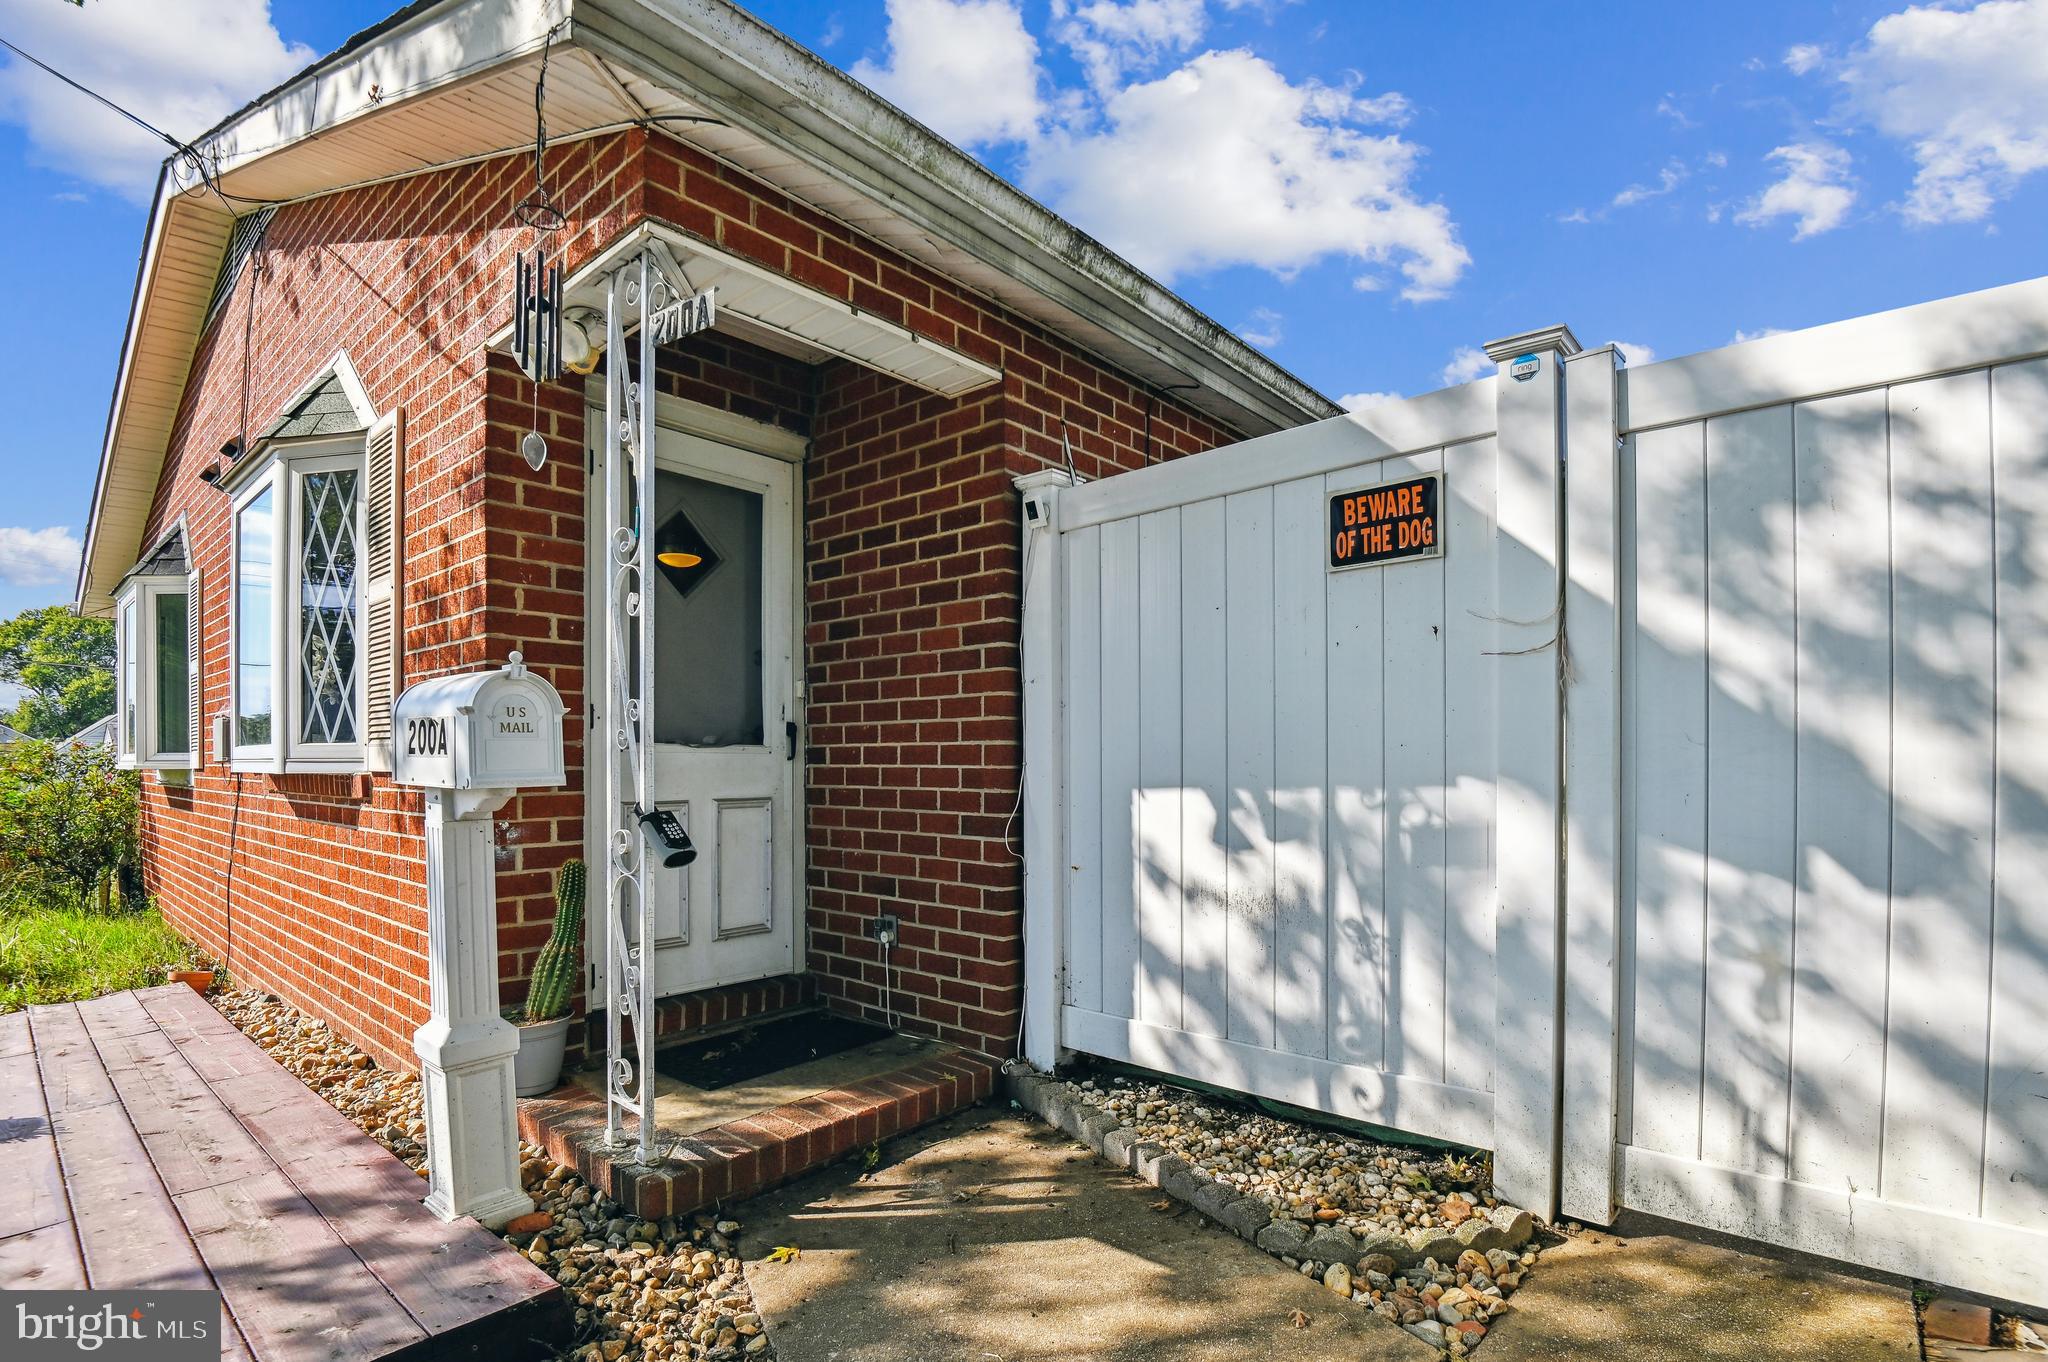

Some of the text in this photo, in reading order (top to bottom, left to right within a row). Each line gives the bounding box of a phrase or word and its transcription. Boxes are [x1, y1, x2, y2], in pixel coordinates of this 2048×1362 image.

[651, 294, 710, 347] 200A
[1517, 363, 1533, 373] ring
[1343, 485, 1424, 526] BEWARE
[1335, 516, 1433, 559] OF THE DOG
[408, 717, 448, 756] 200A
[500, 722, 534, 733] MAIL
